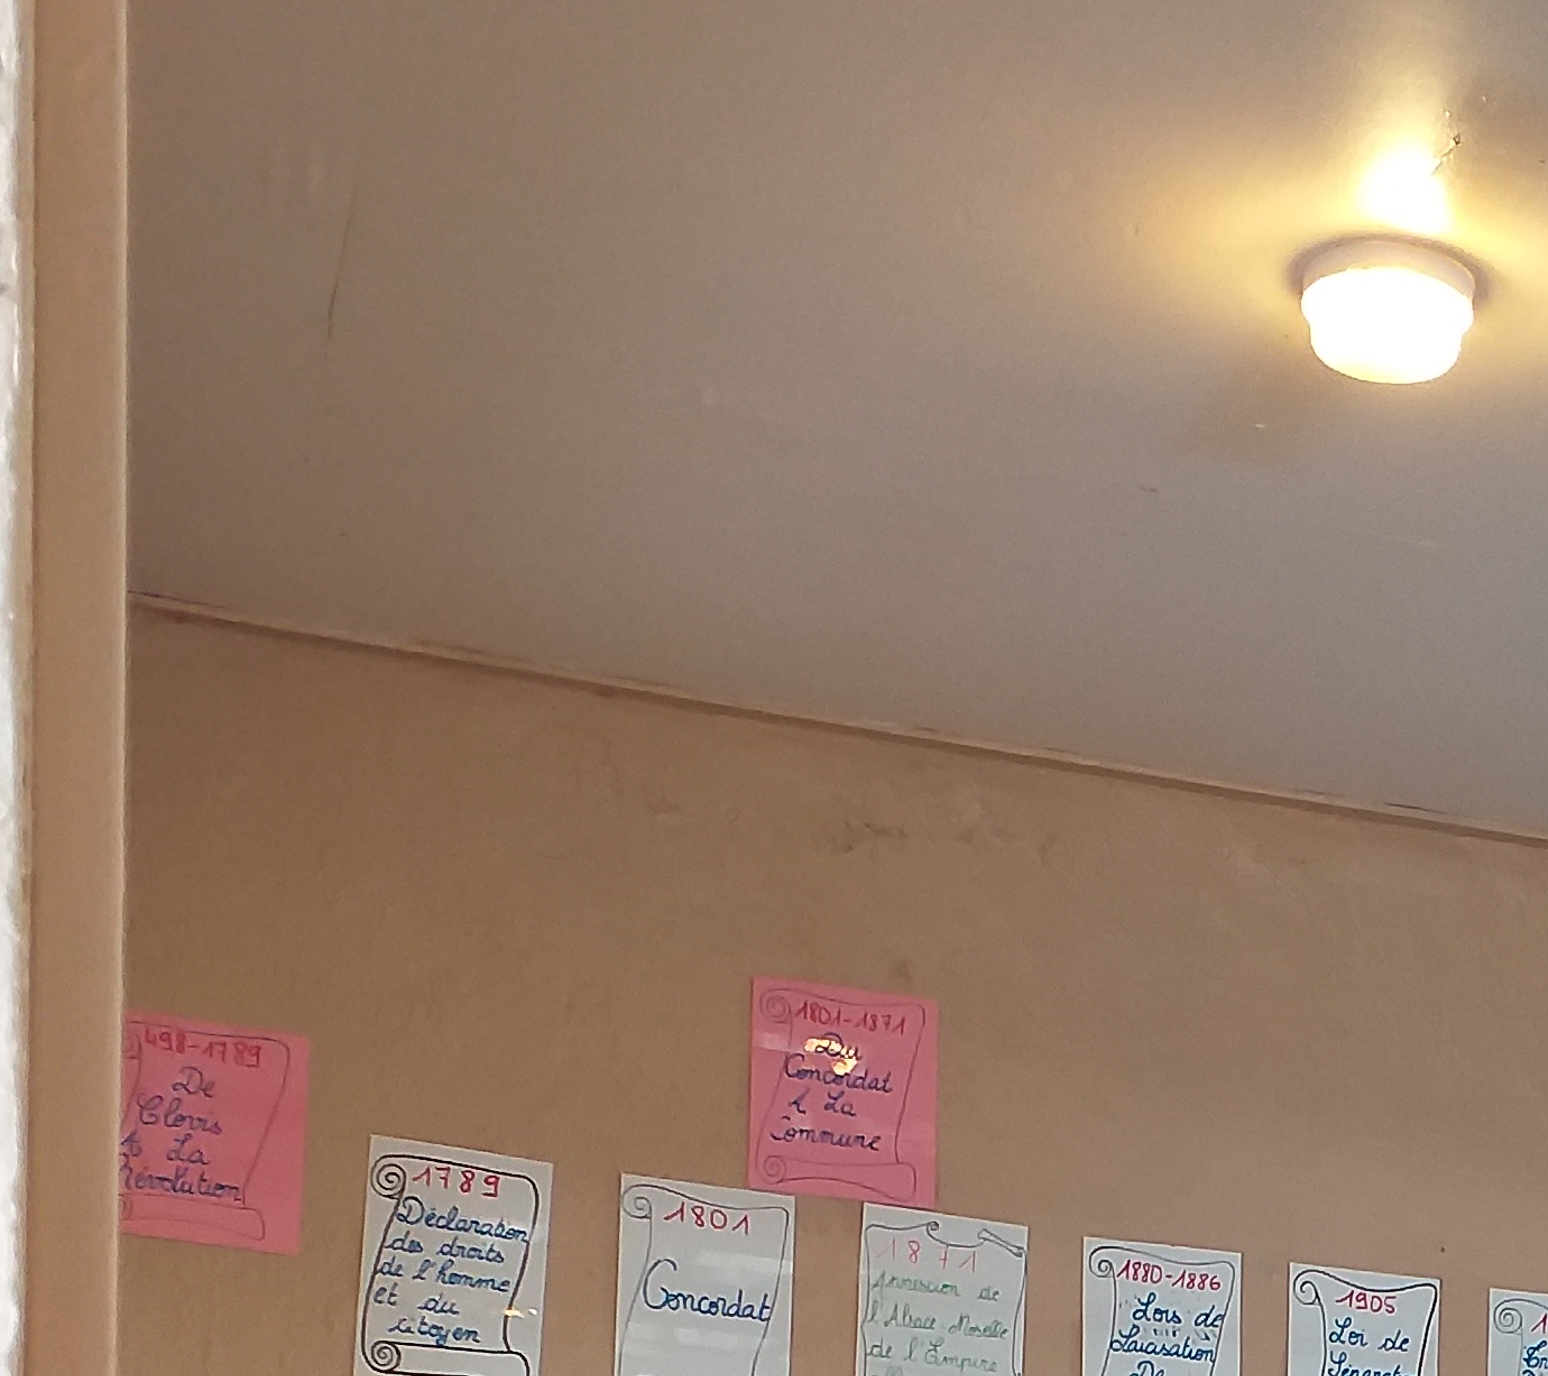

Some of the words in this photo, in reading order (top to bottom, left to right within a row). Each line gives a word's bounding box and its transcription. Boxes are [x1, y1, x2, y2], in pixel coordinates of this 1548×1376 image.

[412, 1166, 500, 1197] 1789
[397, 1196, 530, 1243] Déclaration
[663, 1201, 750, 1235] 1801
[437, 1236, 505, 1264] droits
[376, 1256, 403, 1277] de
[1116, 1259, 1221, 1291] 1880-1886
[373, 1283, 397, 1306] et
[417, 1292, 460, 1314] du
[642, 1258, 772, 1322] Concordat
[1336, 1289, 1398, 1314] 1905
[1133, 1292, 1182, 1326] Lois
[1194, 1305, 1224, 1329] de
[867, 1339, 892, 1359] de
[1329, 1317, 1369, 1347] Loi
[1378, 1329, 1411, 1351] de
